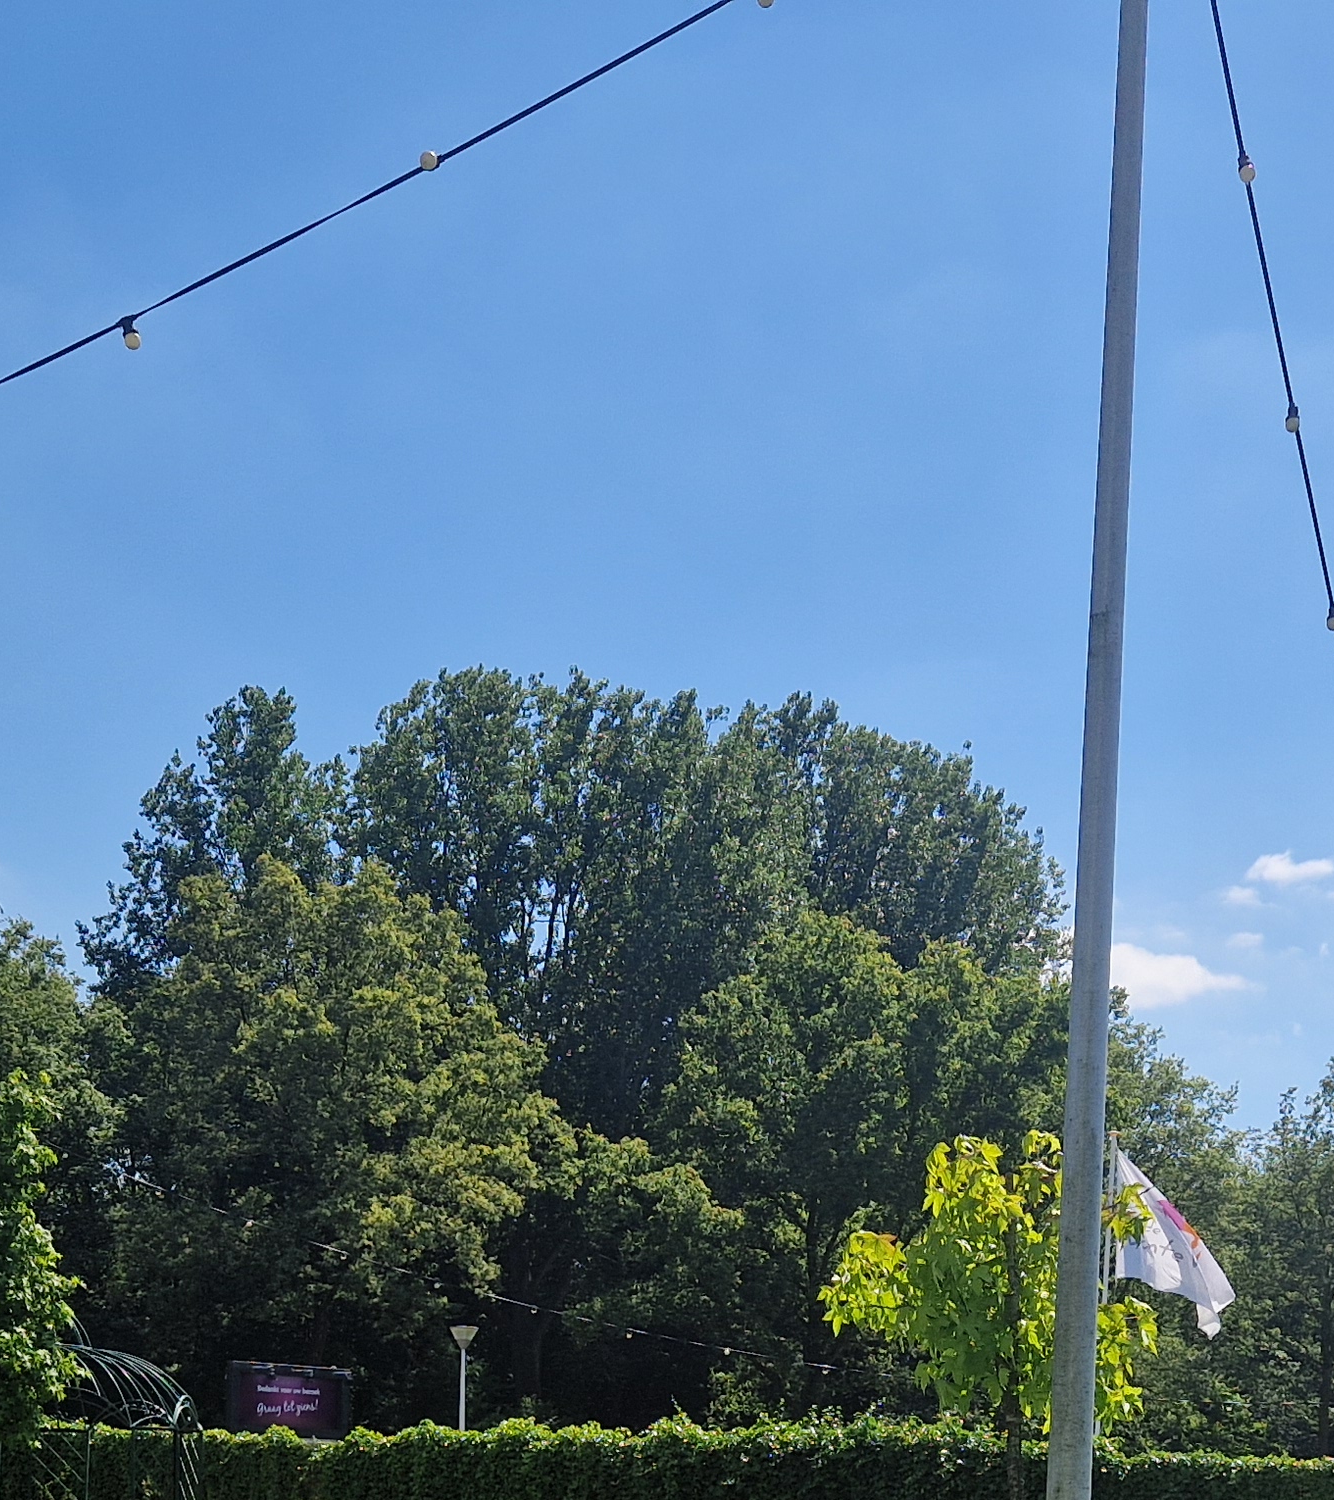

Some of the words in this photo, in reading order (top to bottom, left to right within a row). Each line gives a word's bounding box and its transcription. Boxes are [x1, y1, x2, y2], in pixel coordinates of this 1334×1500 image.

[257, 1402, 282, 1417] Graag
[283, 1399, 296, 1412] tot
[295, 1398, 319, 1417] ziens!
